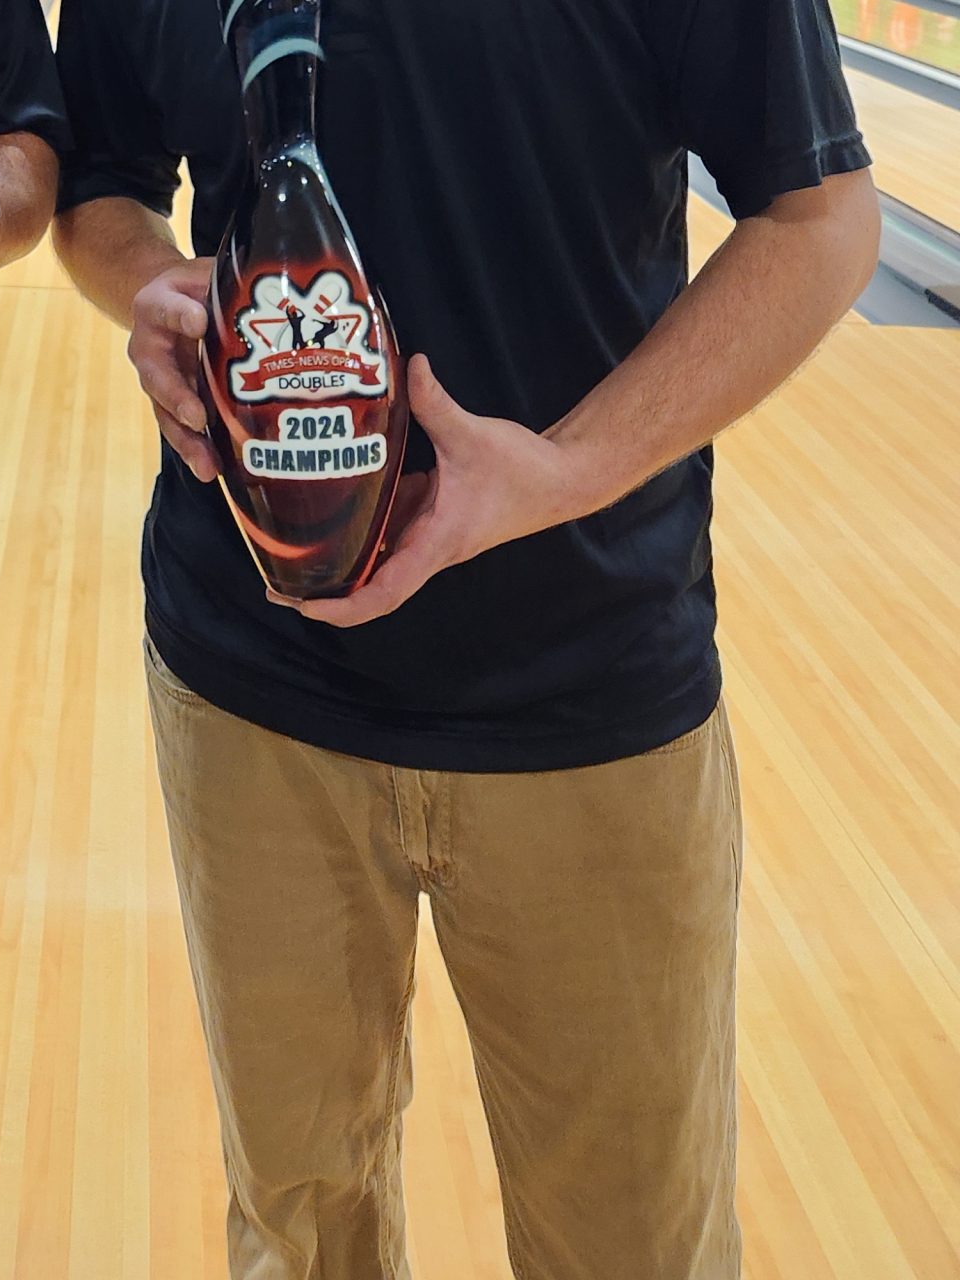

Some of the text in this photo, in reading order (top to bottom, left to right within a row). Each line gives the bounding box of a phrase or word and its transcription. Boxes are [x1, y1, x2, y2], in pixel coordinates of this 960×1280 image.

[278, 374, 346, 390] DOUBLES
[286, 415, 347, 440] 2024
[249, 441, 382, 472] CHAMPIONS
